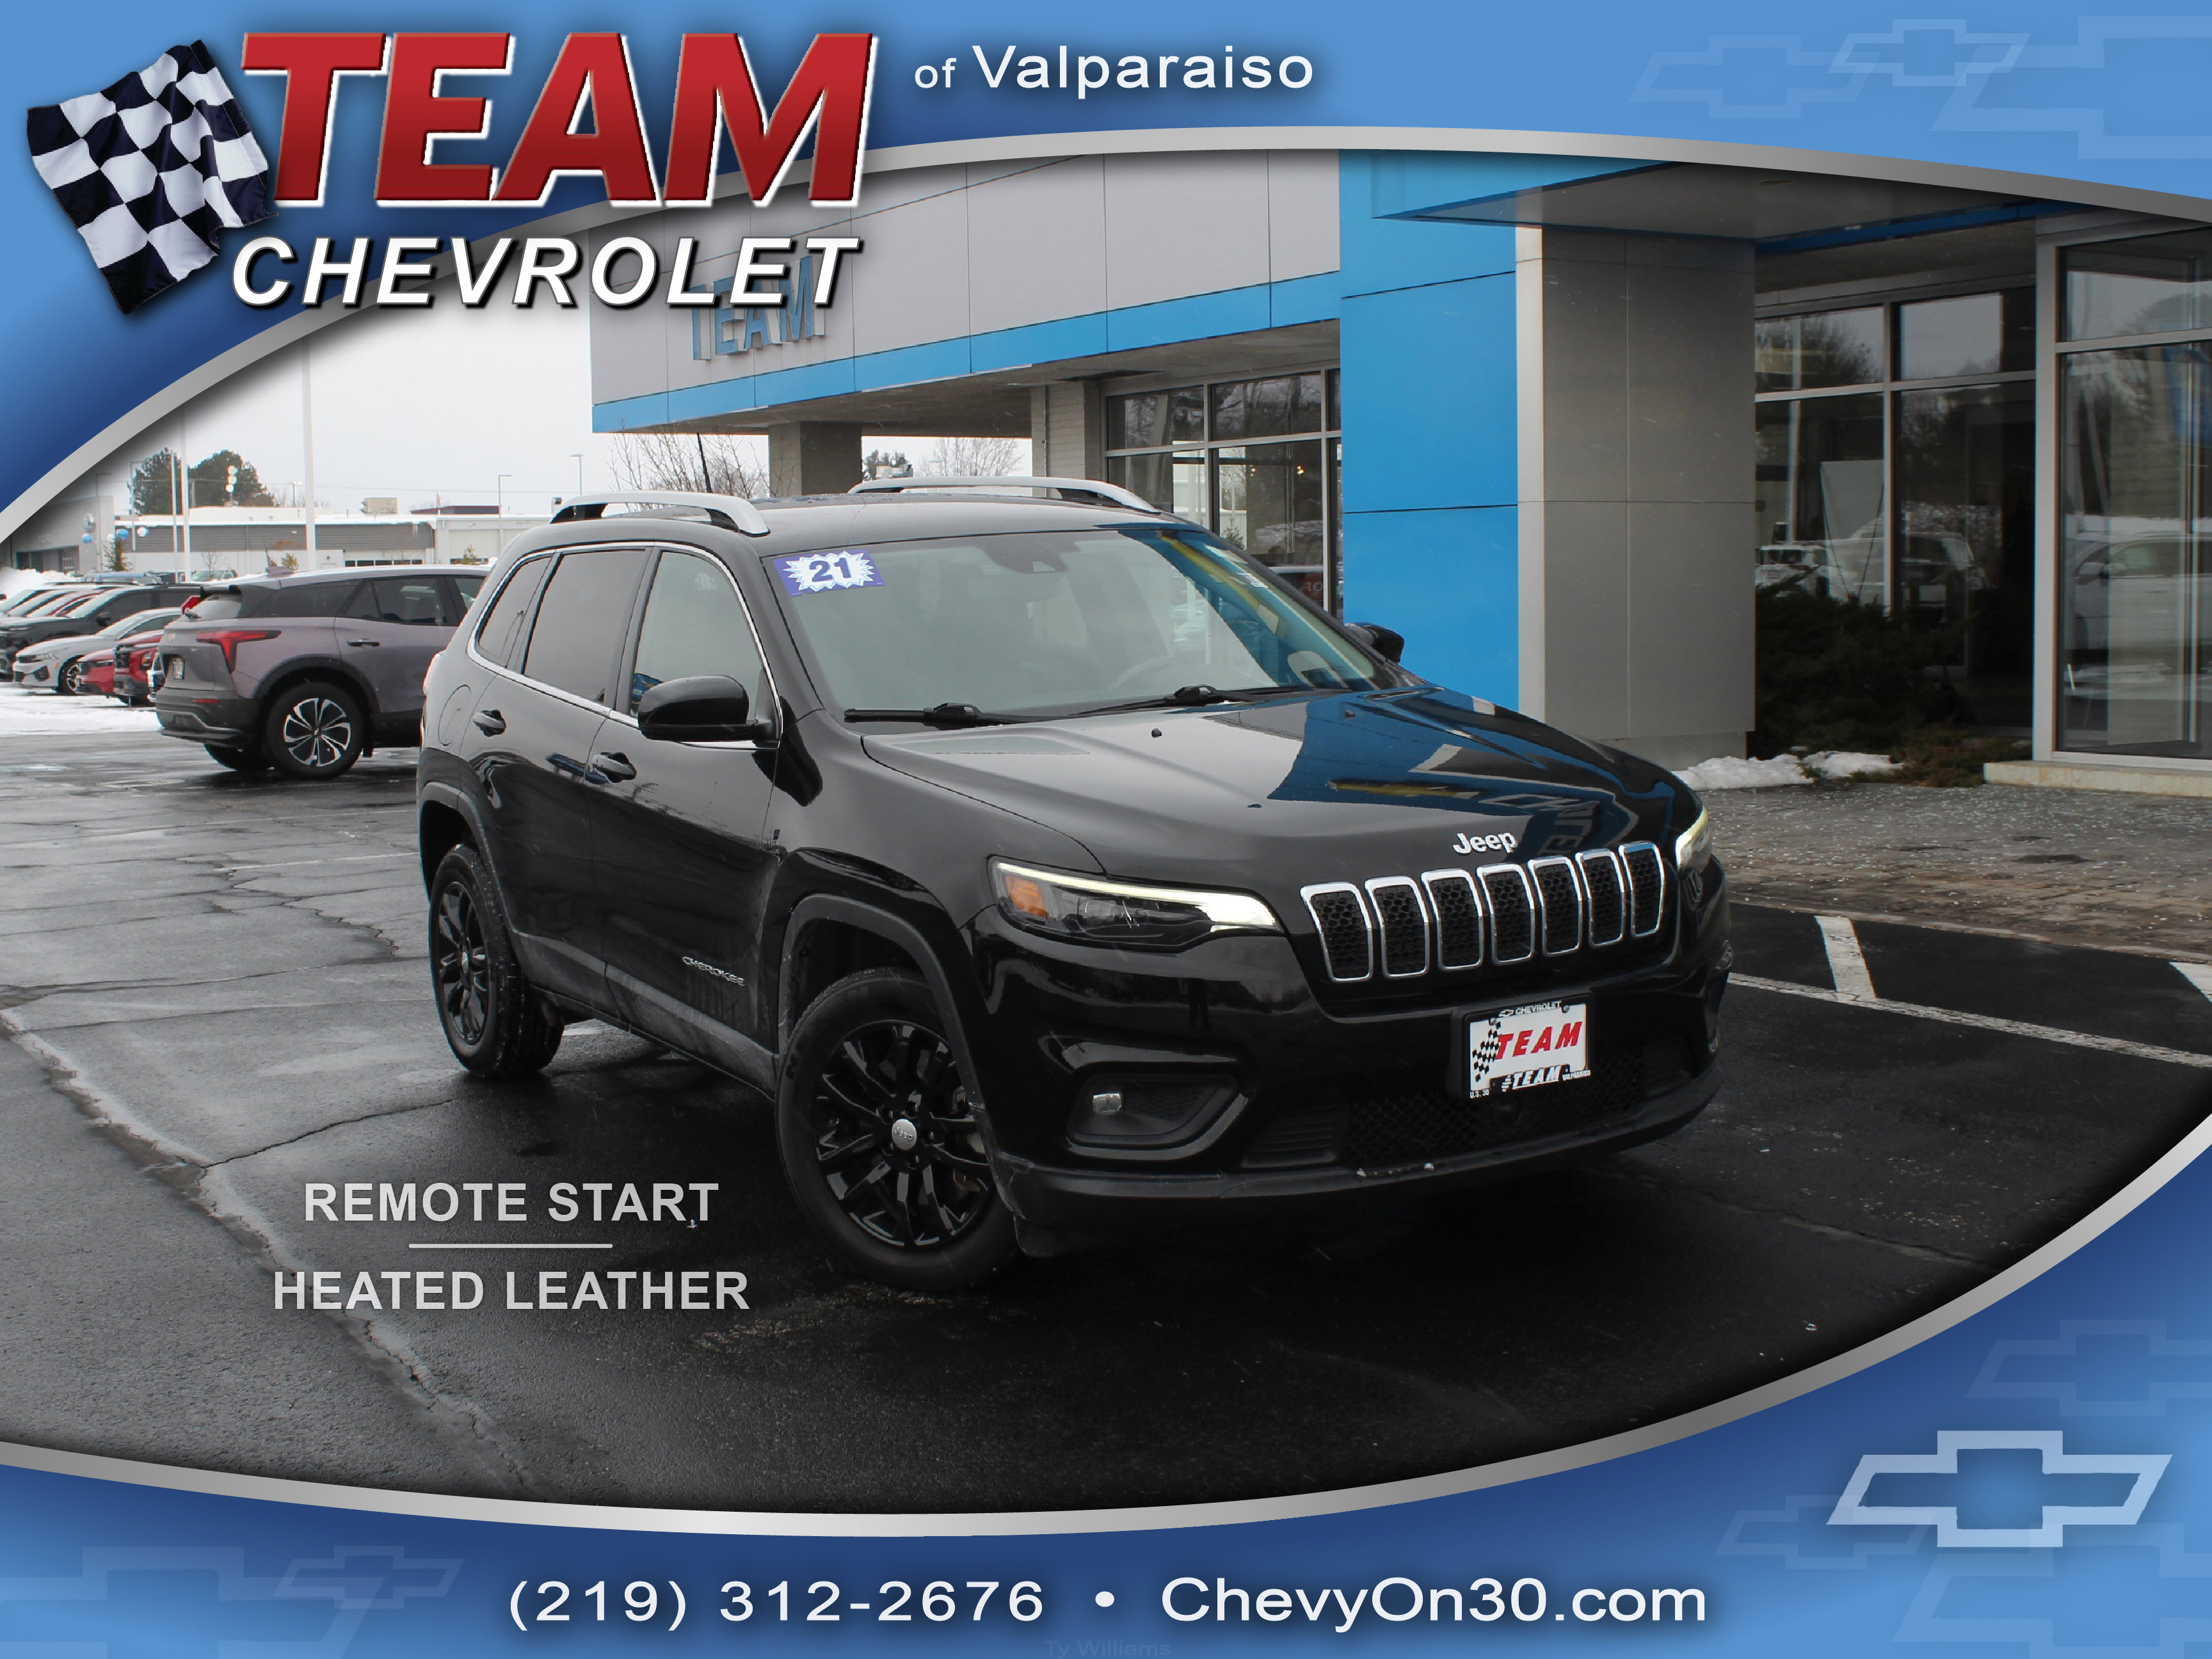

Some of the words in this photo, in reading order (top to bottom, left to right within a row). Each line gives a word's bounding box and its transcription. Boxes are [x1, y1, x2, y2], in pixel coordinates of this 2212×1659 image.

[809, 557, 852, 582] 21
[1453, 832, 1518, 854] Jeep
[682, 956, 745, 986] CHEROKEE
[1515, 1000, 1562, 1015] CHEVROLET
[1495, 1022, 1582, 1059] TEAM
[1512, 1066, 1562, 1088] TEAM
